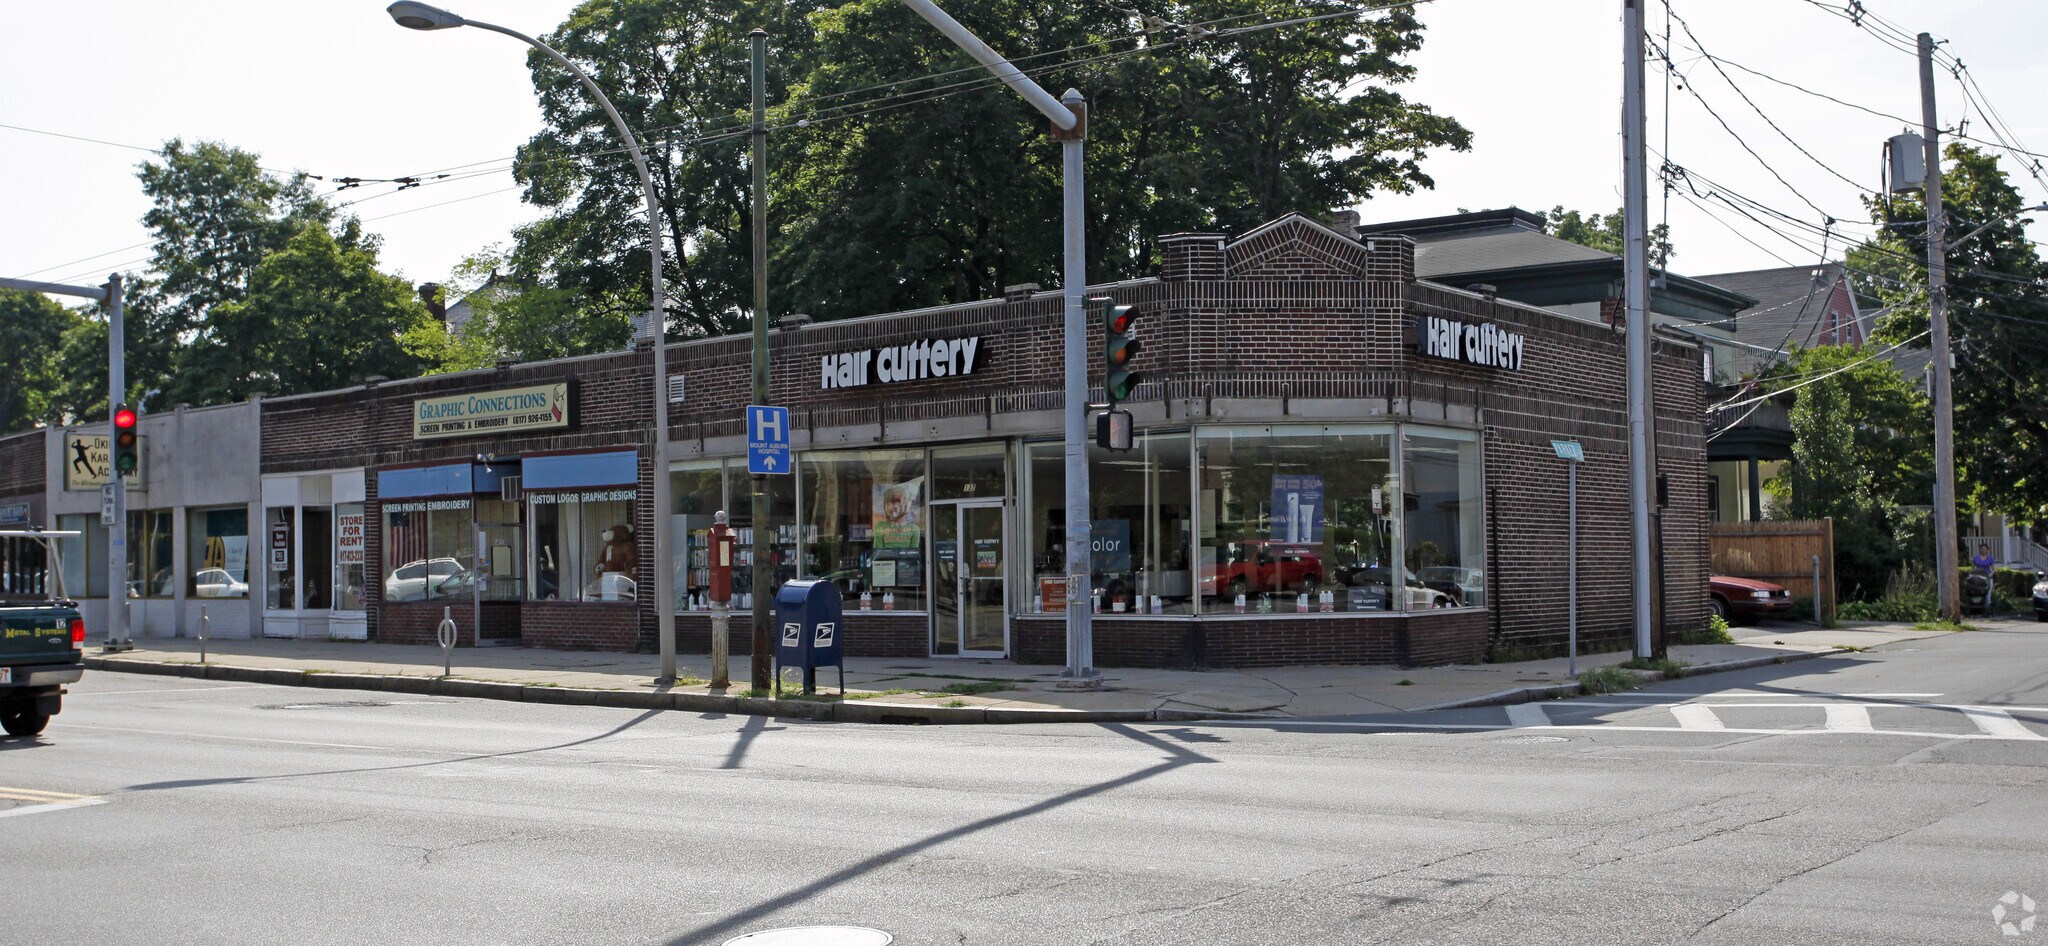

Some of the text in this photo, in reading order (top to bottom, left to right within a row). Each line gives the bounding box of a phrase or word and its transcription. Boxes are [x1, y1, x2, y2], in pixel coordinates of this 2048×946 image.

[419, 392, 547, 419] GRAPHIC CONNECTIONS
[420, 424, 439, 433] SCREEN
[441, 421, 465, 432] PRINTING
[467, 421, 472, 429] &
[474, 417, 509, 428] EMBROIDERY
[756, 409, 781, 442] H
[530, 489, 637, 504] CUSTOM LOGOS GRAPHIC DESIGNS
[382, 499, 471, 513] SCREEN PRINTING EMBROIDERY
[340, 515, 363, 526] STORE
[343, 526, 360, 536] FOR
[340, 536, 363, 546] RENT
[1090, 536, 1121, 552] olor
[5, 627, 67, 638] METAL SYSTEMS
